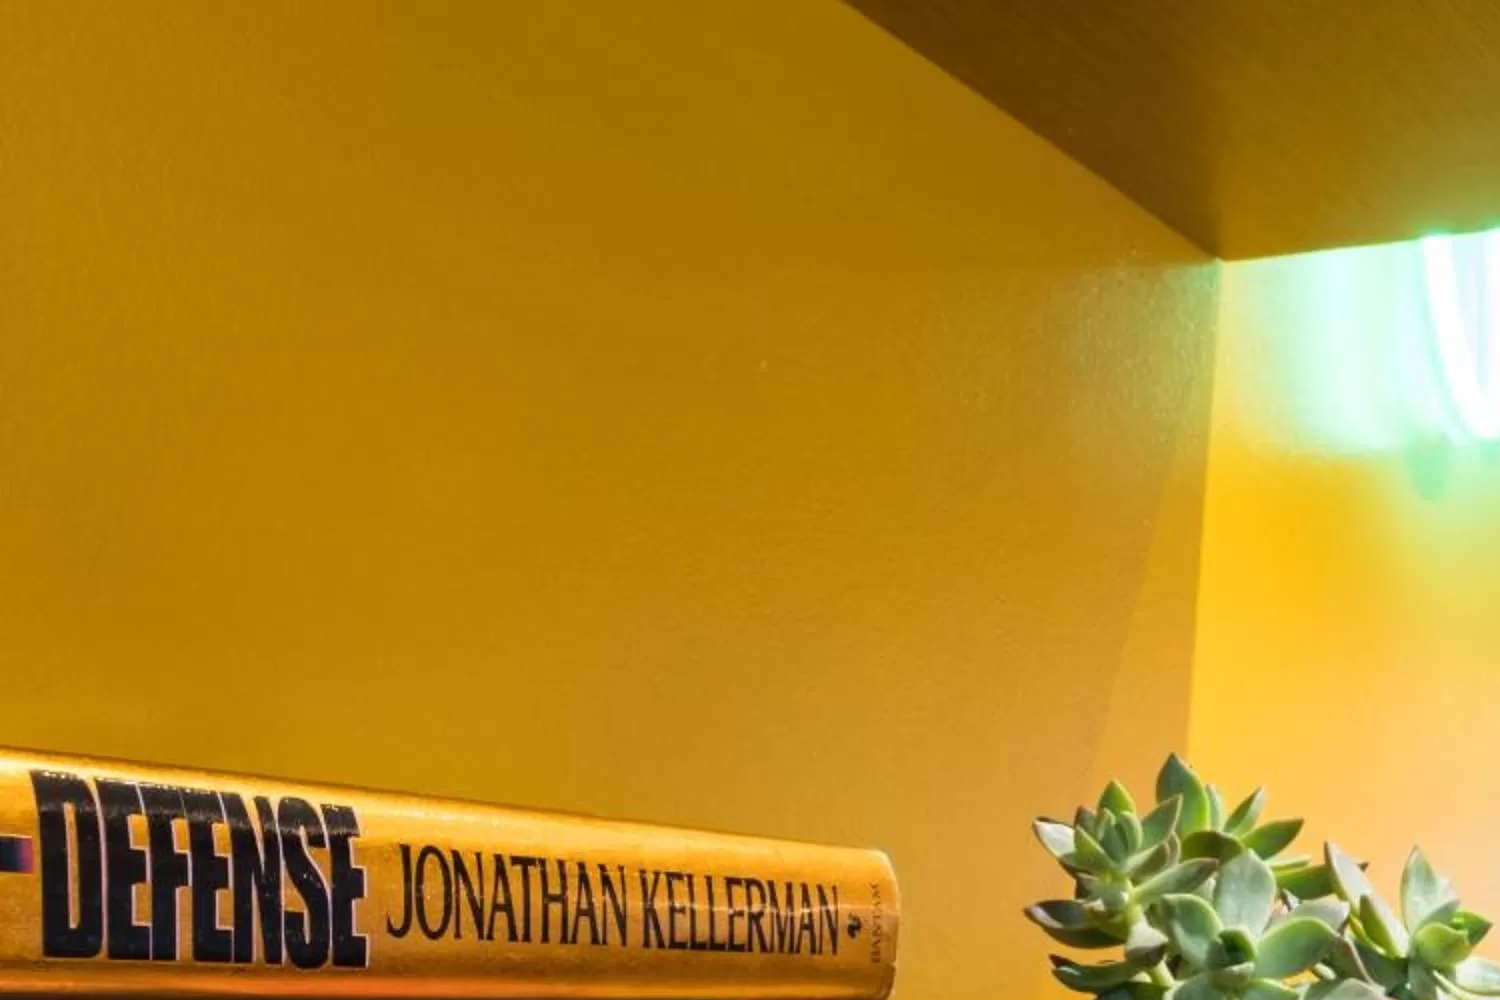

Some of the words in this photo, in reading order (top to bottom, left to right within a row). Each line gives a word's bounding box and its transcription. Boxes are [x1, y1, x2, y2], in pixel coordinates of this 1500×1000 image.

[29, 768, 370, 970] DEFENSE
[385, 843, 628, 947] JONATHAN
[638, 867, 840, 956] KELLERMAN
